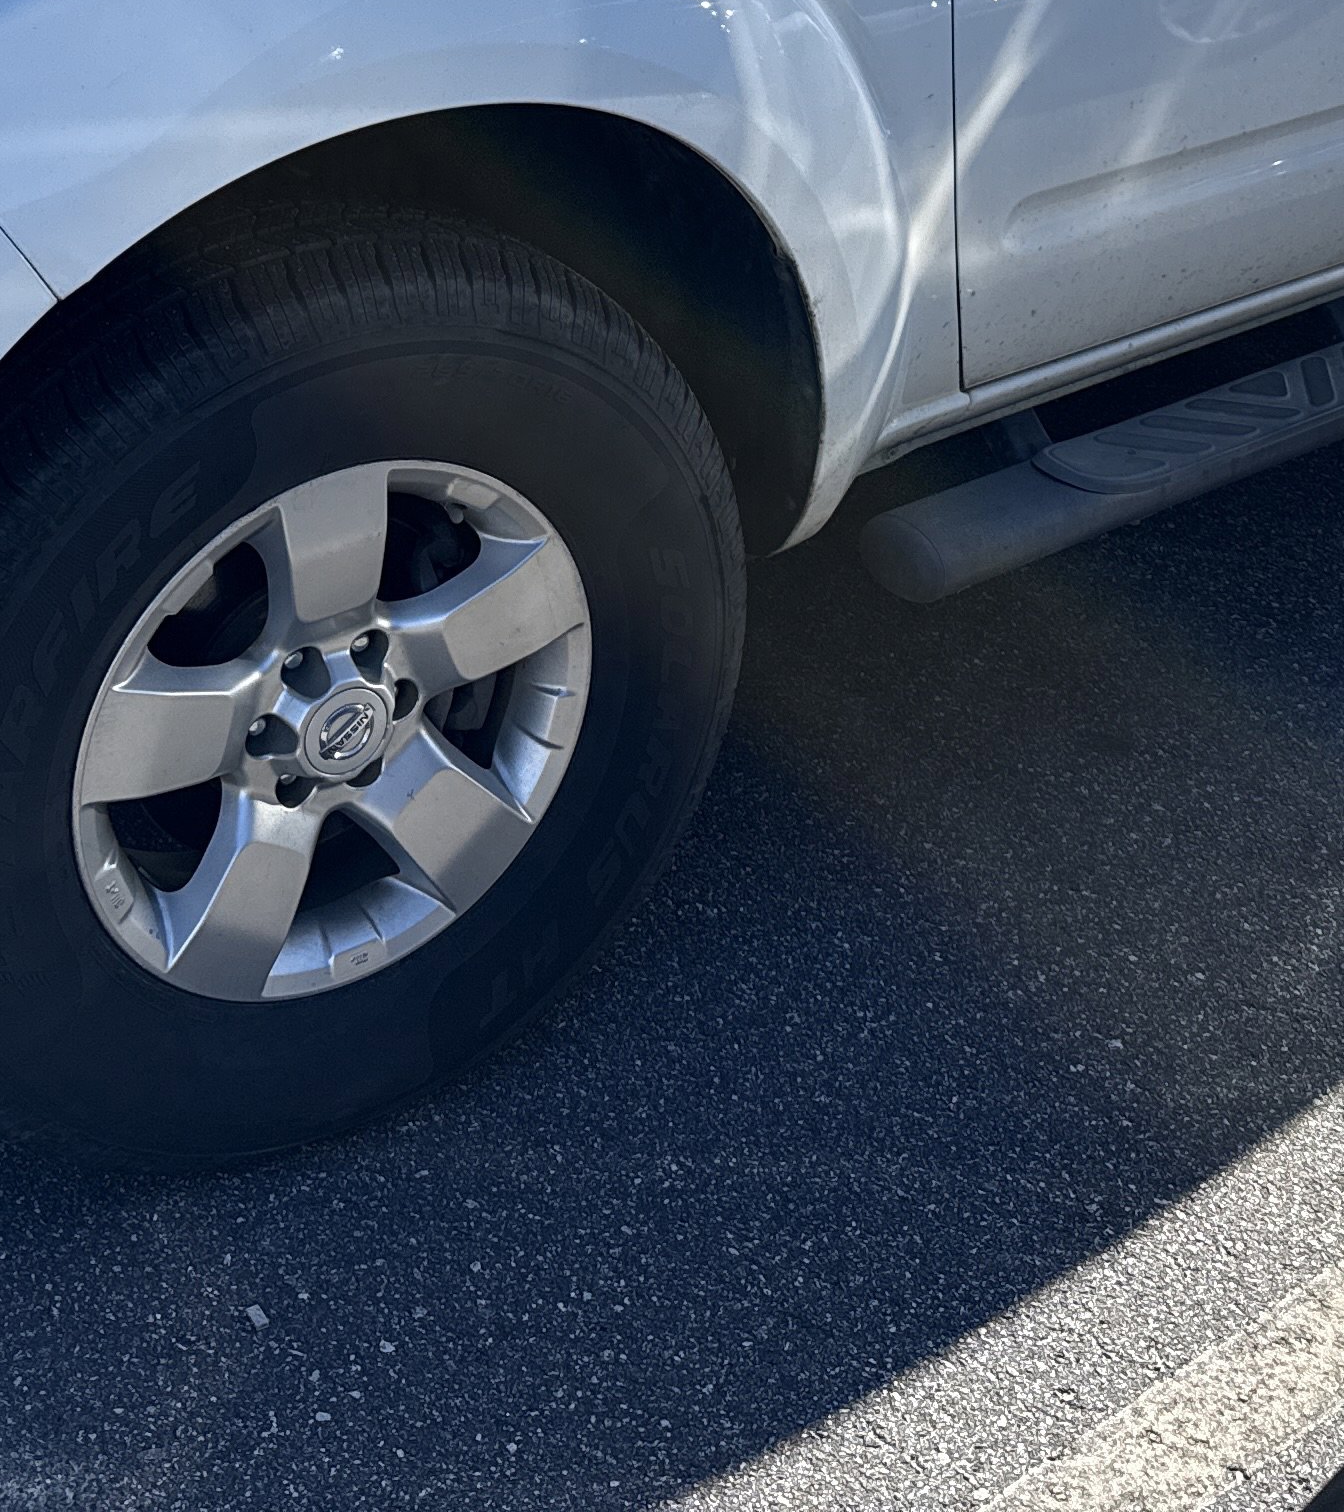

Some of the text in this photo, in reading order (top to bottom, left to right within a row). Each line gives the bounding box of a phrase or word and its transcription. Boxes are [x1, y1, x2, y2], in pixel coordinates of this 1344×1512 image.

[327, 711, 370, 753] NISSAN
[479, 545, 694, 1030] SOLARUS HT
